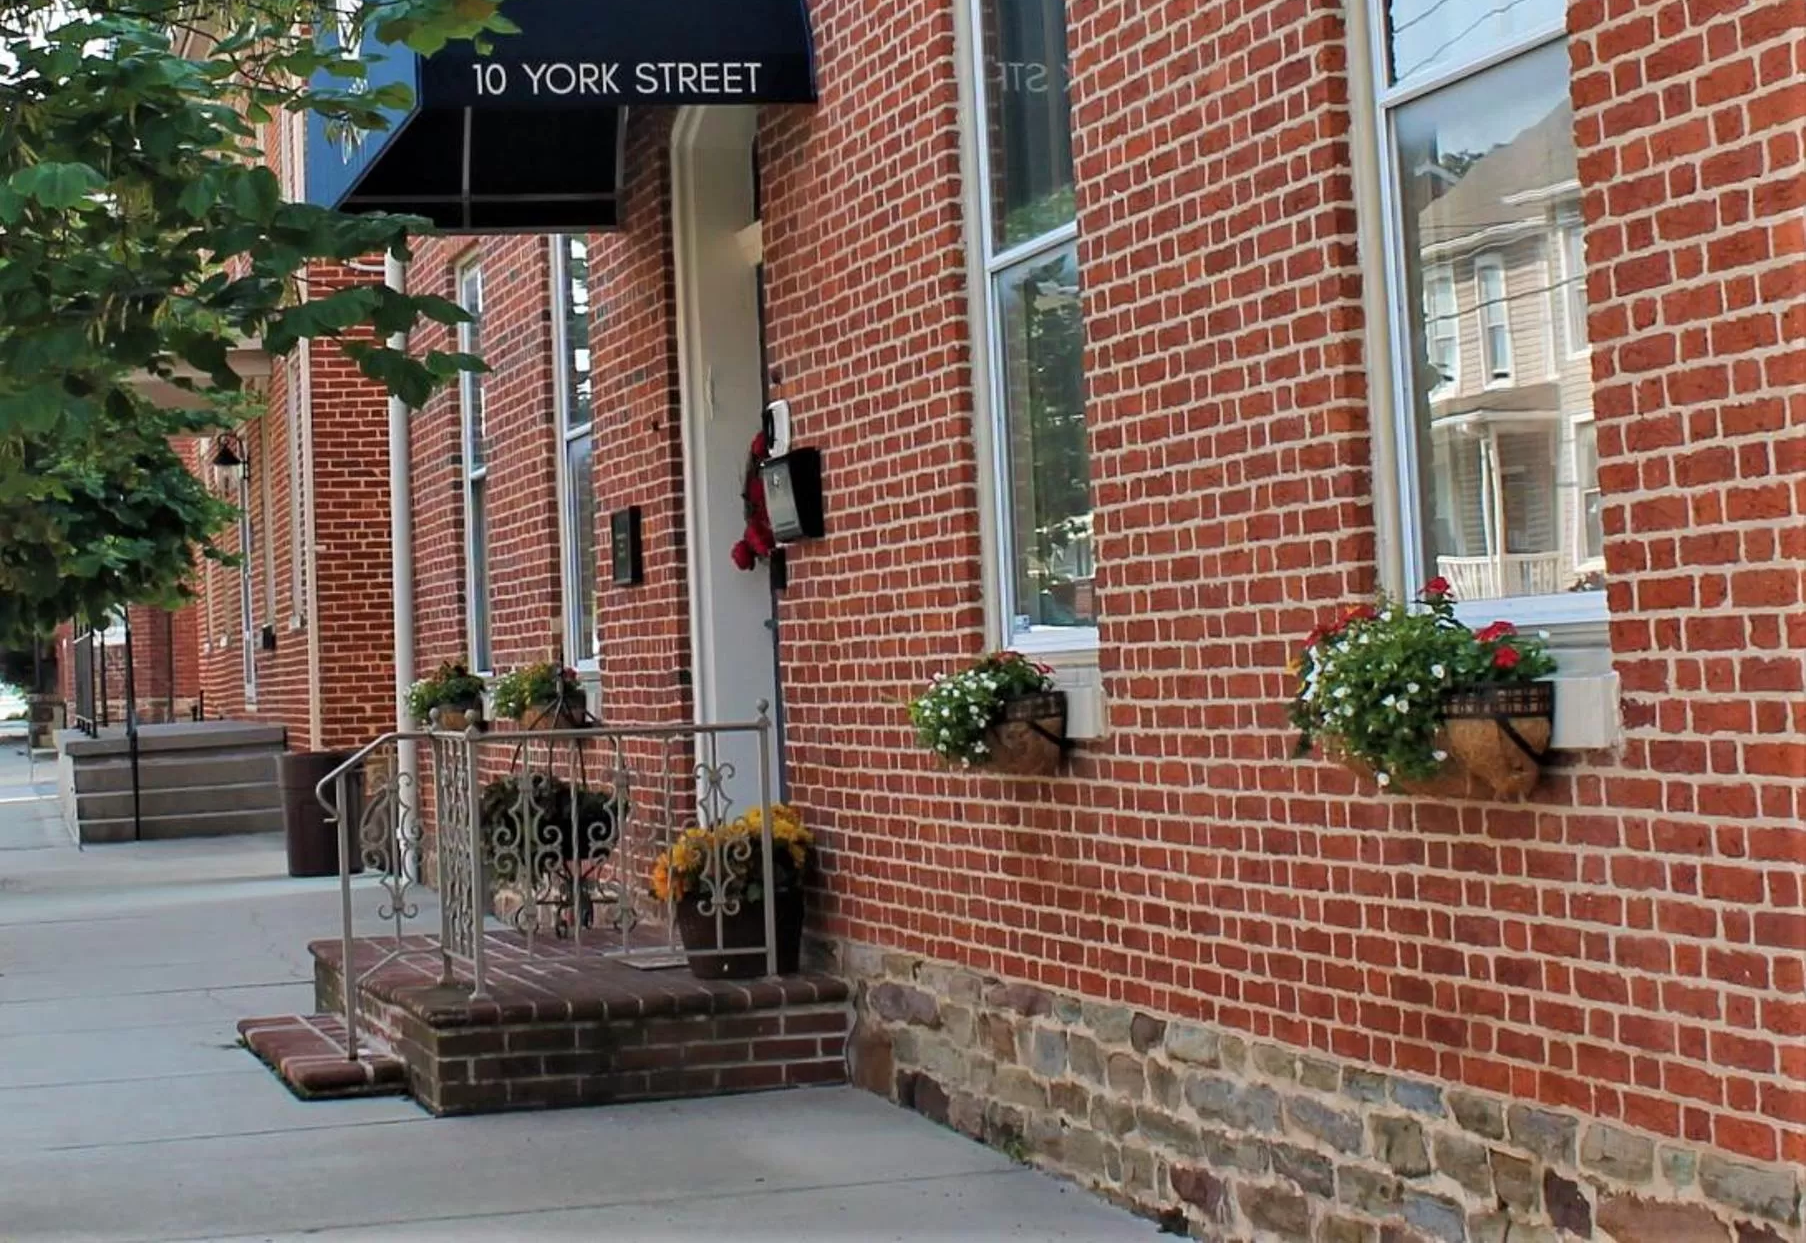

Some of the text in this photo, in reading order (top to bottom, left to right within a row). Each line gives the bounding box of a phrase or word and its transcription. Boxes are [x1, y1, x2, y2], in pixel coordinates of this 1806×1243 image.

[472, 62, 762, 95] 10 YORK STREET
